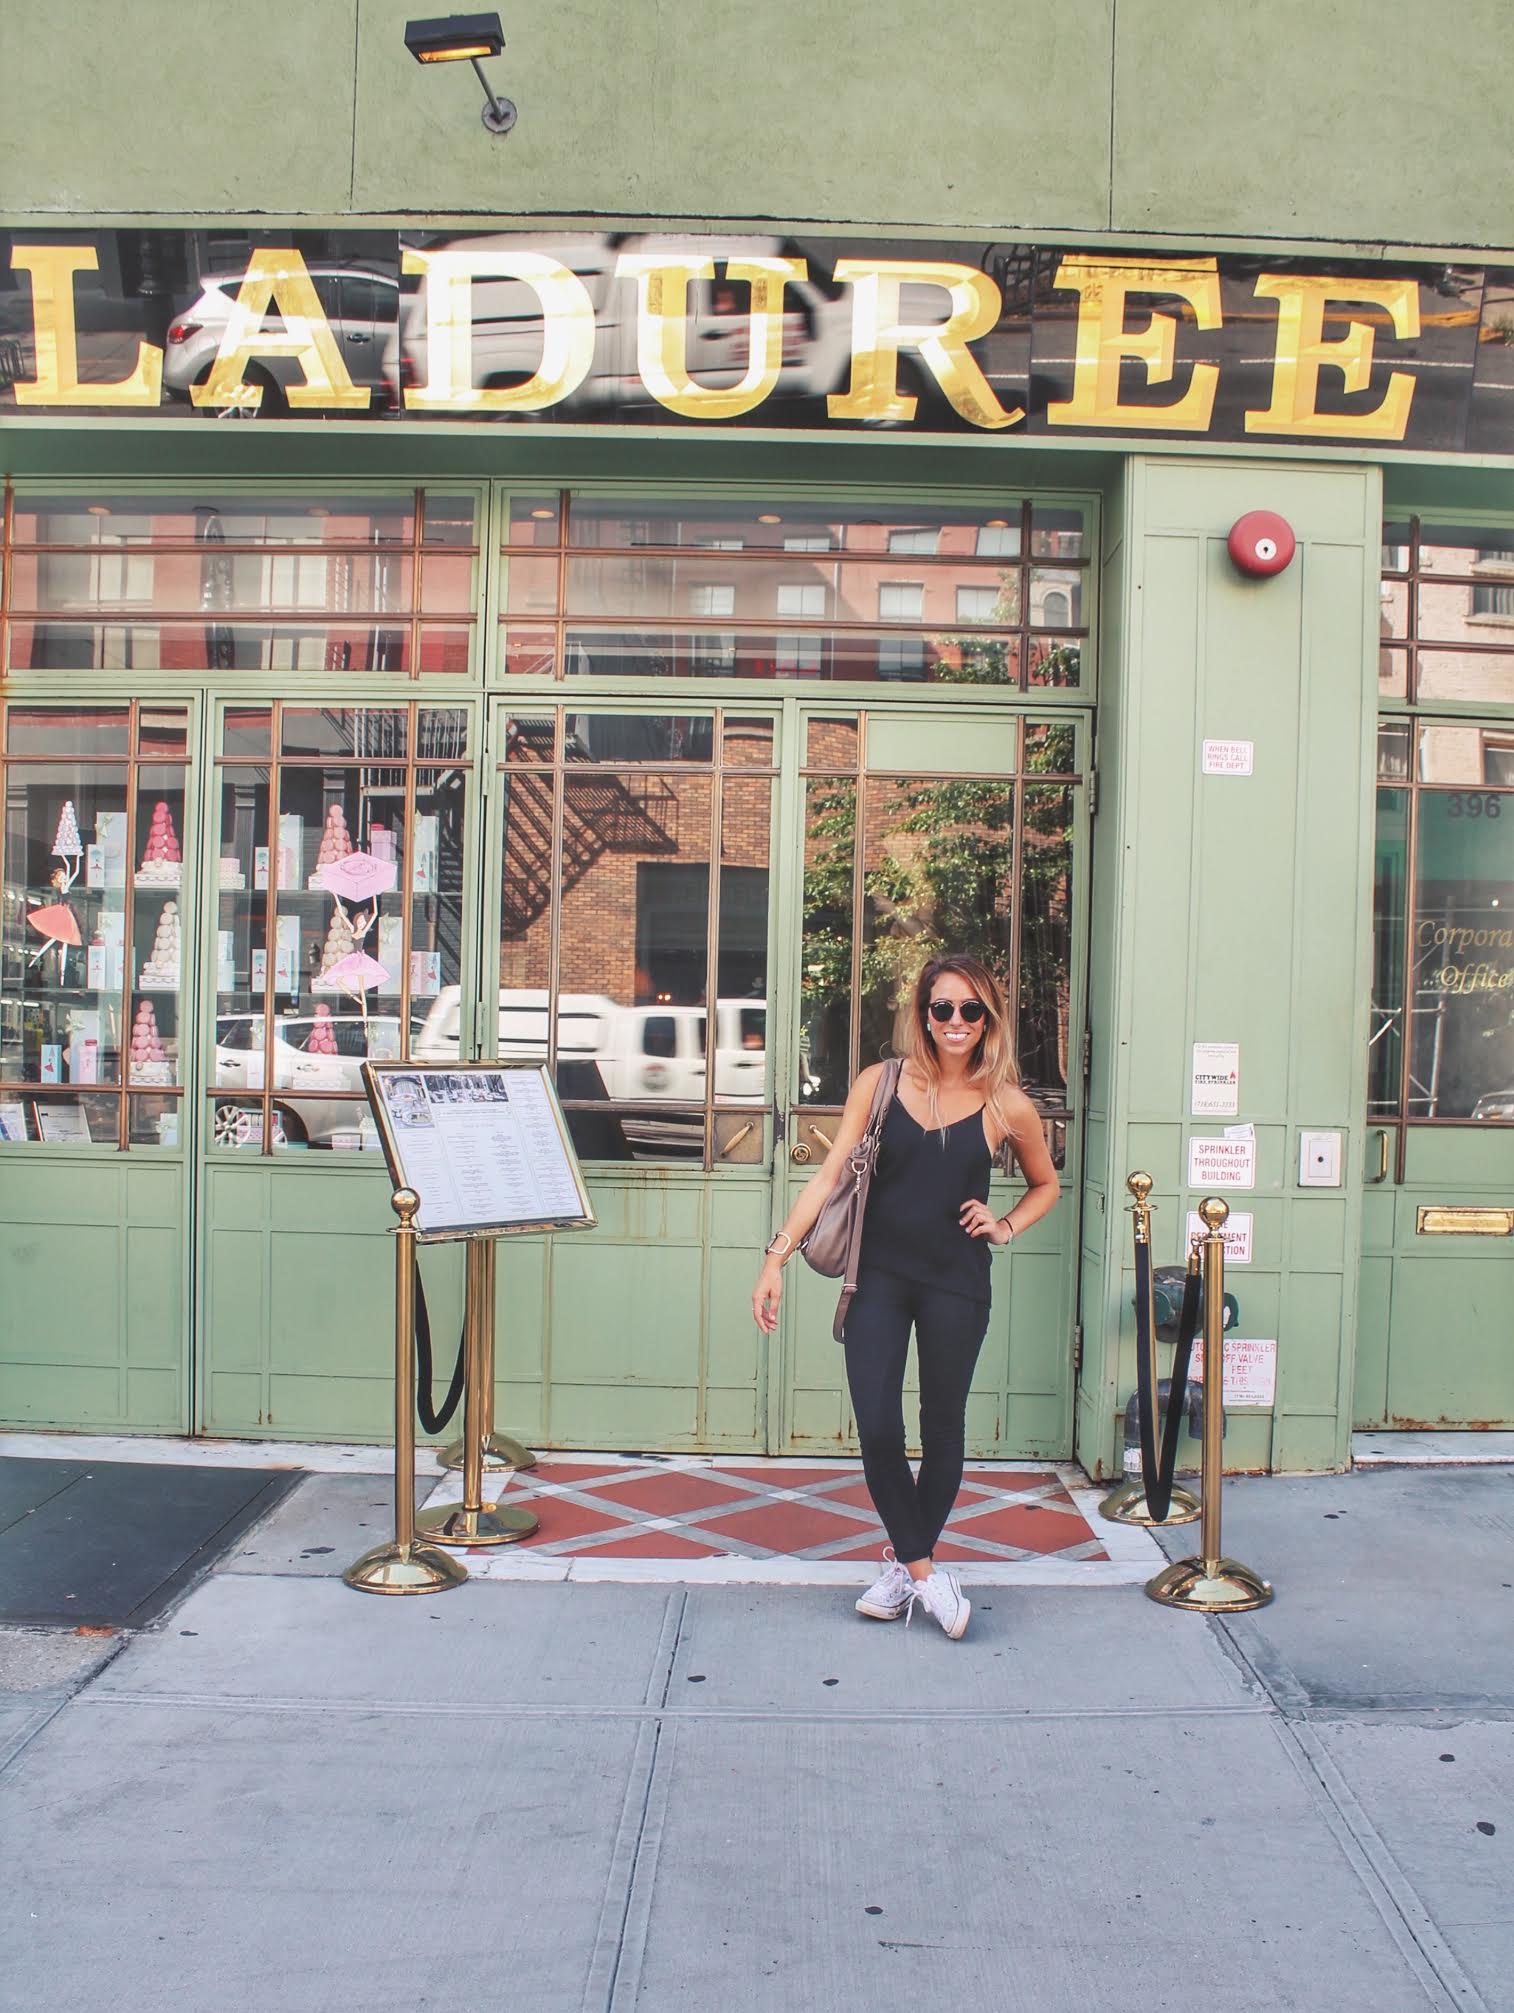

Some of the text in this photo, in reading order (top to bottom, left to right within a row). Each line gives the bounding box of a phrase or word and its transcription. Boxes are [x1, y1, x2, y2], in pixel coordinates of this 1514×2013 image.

[1207, 745, 1229, 753] WHEN
[1448, 793, 1501, 819] 396
[1441, 962, 1508, 995] Office
[1198, 1144, 1246, 1155] SPRINKLER
[1194, 1157, 1250, 1168] THROUGHOUT
[1201, 1170, 1241, 1181] BUILDING
[1231, 1342, 1276, 1352] SPRINKLER
